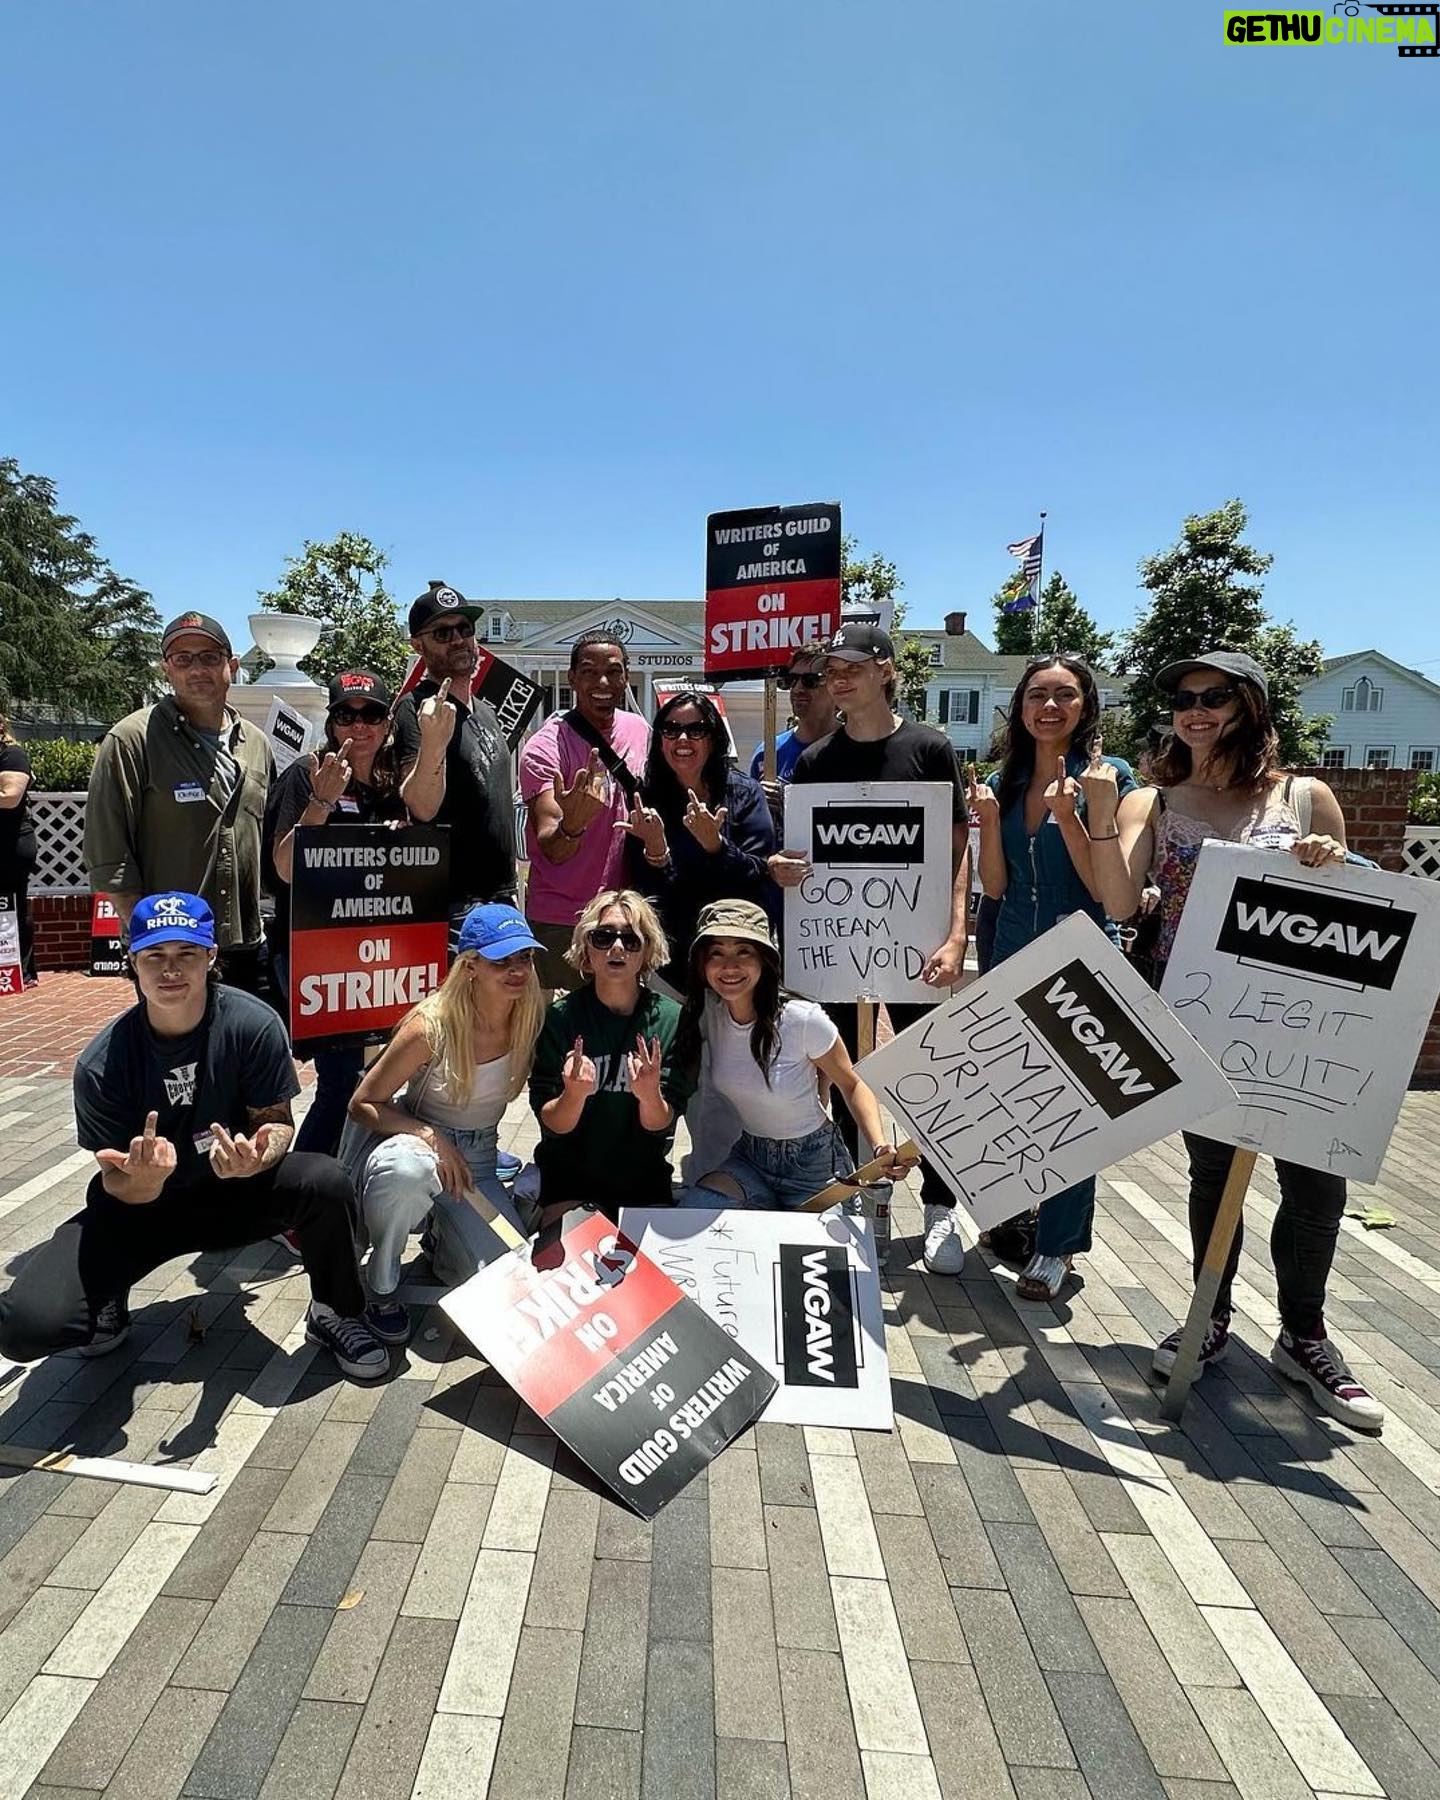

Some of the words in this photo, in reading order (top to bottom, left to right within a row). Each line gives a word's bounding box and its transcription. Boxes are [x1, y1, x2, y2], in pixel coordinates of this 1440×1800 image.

[715, 522, 783, 545] WRITERS
[785, 517, 831, 536] GUILD
[763, 543, 780, 557] OF
[736, 558, 807, 580] AMERICA
[757, 593, 786, 613] ON
[710, 613, 832, 654] STRIKE!
[638, 655, 694, 666] STUDIOS
[658, 683, 694, 691] WRITERS
[694, 684, 715, 692] GUILD
[500, 678, 535, 741] RIKE
[276, 718, 303, 743] WGAW
[816, 823, 920, 845] WGAW
[304, 847, 386, 868] WRITERS
[389, 846, 440, 866] GUILD
[364, 874, 384, 891] OF
[800, 873, 853, 906] GO
[862, 875, 922, 912] ON
[146, 917, 198, 930] RHUDE
[331, 896, 413, 919] AMERICA
[799, 917, 890, 938] STREAM
[1236, 901, 1402, 961] WGAW
[358, 939, 391, 963] ON
[798, 944, 838, 970] THE
[300, 963, 439, 1016] STRIKE!
[1173, 972, 1212, 1015] 2
[1229, 984, 1373, 1037] LEGIT
[1044, 977, 1155, 1096] WGAW
[949, 991, 1098, 1152] HUMAN
[1220, 1040, 1374, 1106] QUIT!
[920, 1022, 1067, 1195] WRITERS
[895, 1072, 1015, 1197] ONLY!
[573, 1312, 618, 1354] ON
[801, 1249, 836, 1383] WGAW
[592, 1330, 681, 1413] AMERICA
[651, 1382, 676, 1412] OF
[680, 1357, 752, 1440] WRITERS
[617, 1429, 679, 1486] GUILD
